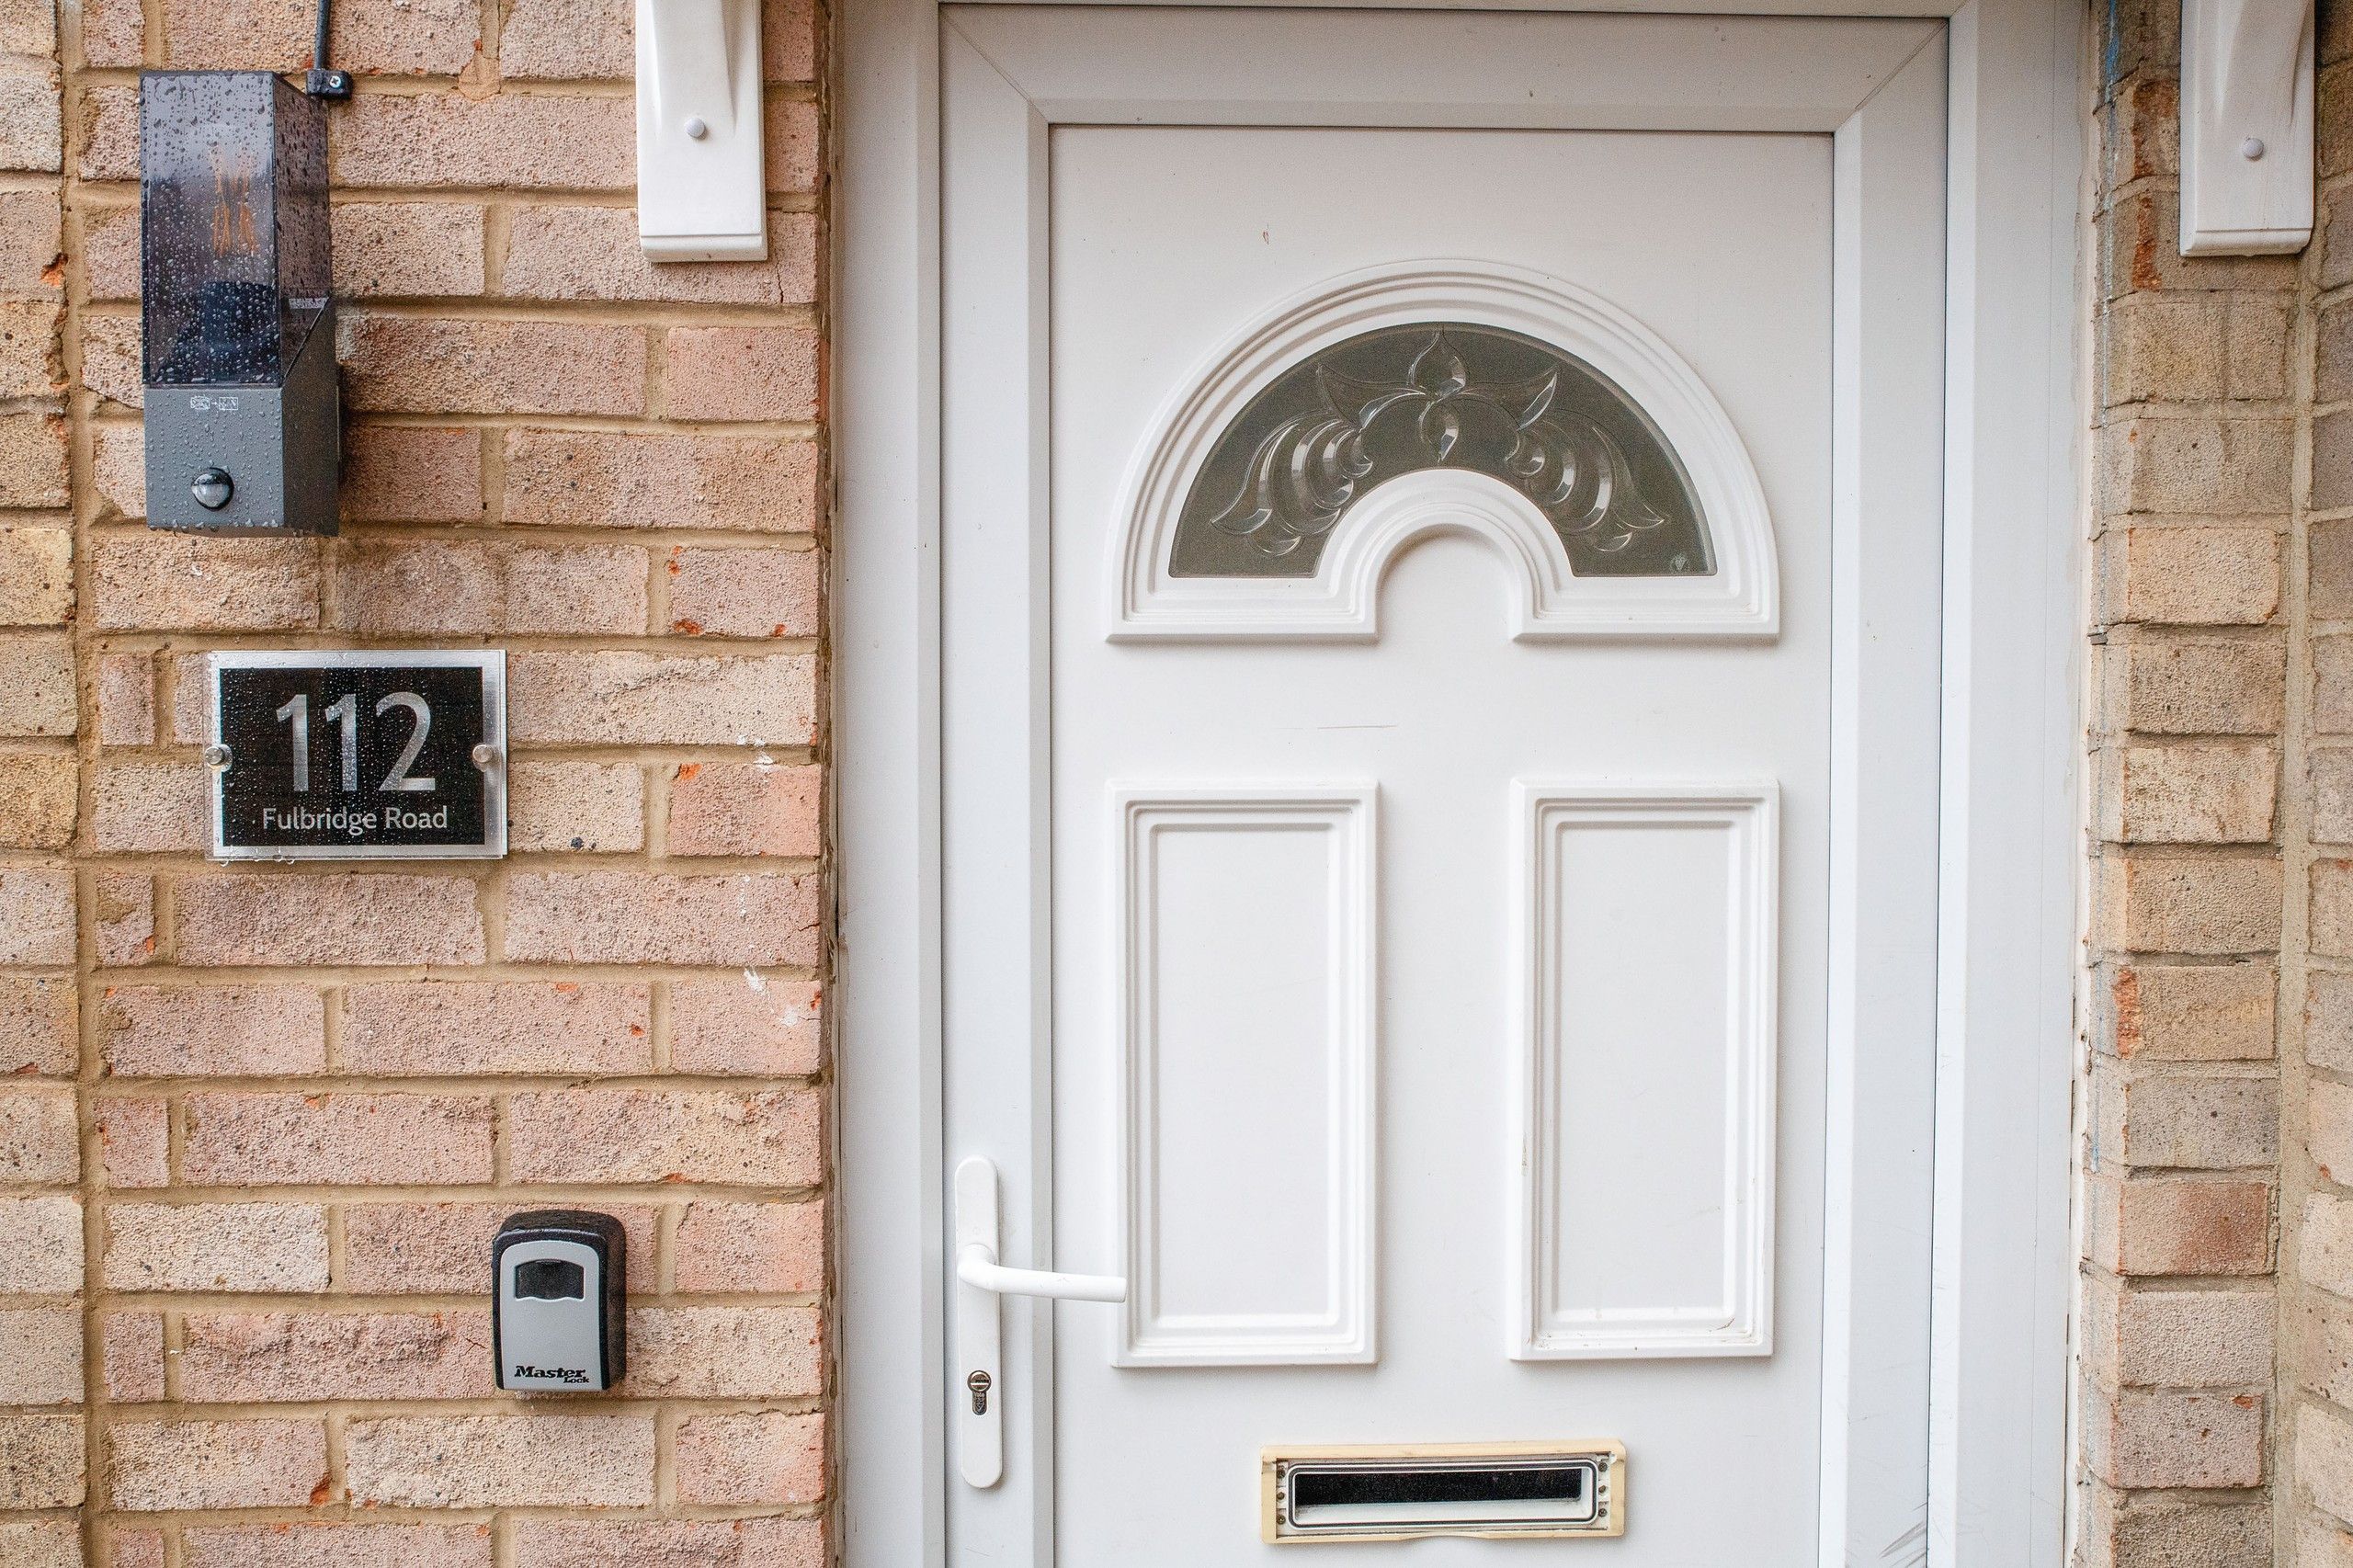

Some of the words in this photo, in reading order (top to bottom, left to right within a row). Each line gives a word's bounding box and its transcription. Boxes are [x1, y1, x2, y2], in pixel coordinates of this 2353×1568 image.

[276, 691, 436, 791] 112
[263, 806, 377, 835] Fulbridge
[385, 805, 448, 828] Road
[514, 1366, 586, 1379] Master
[563, 1376, 590, 1384] Lock
